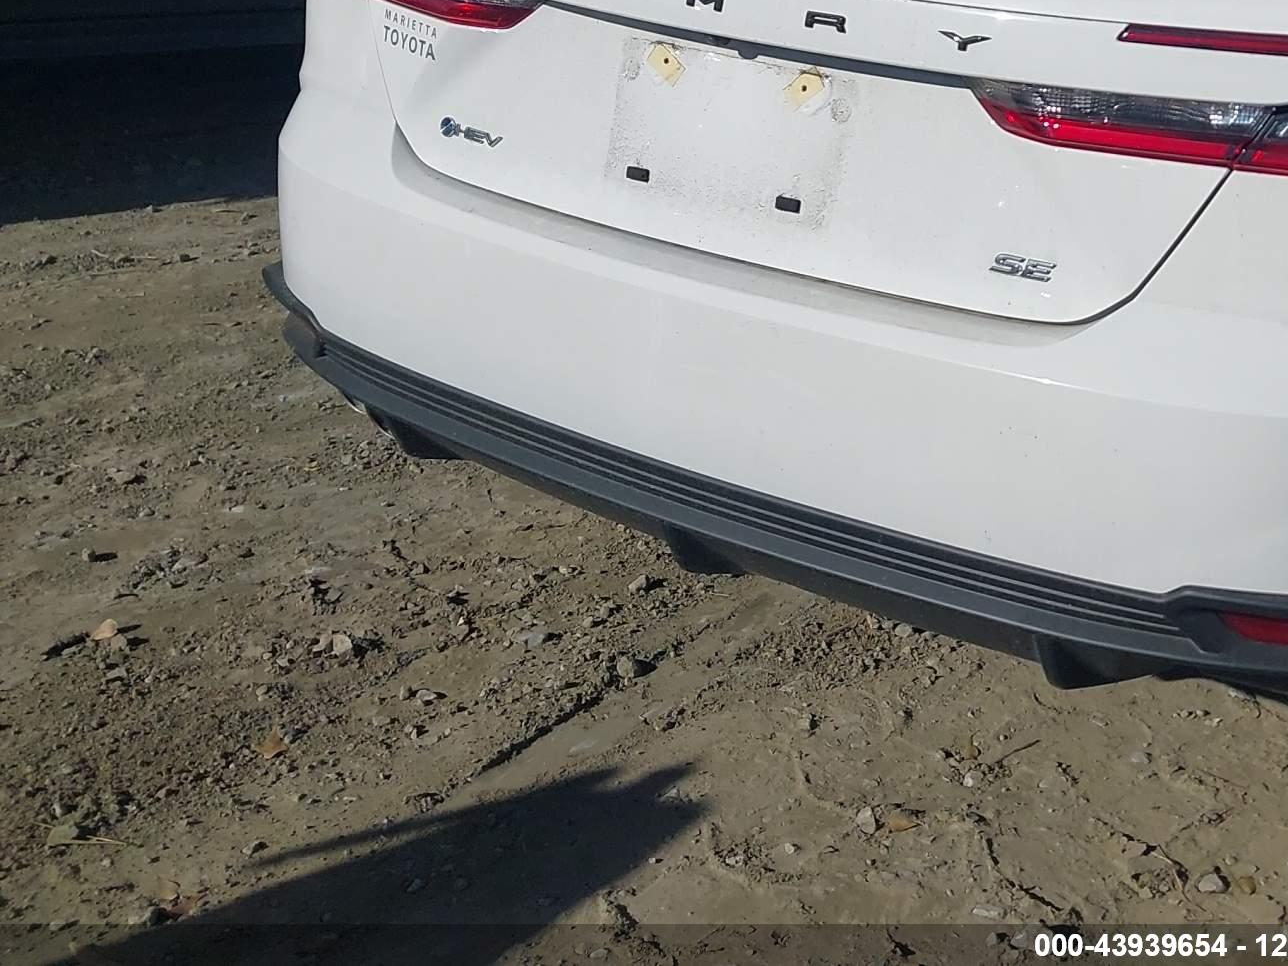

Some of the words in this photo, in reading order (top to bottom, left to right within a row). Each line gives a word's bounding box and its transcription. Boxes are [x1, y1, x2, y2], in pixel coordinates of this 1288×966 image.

[384, 8, 437, 39] MARIETTA
[383, 24, 436, 61] TOYOTA
[455, 124, 503, 148] HEV
[988, 253, 1057, 283] SE
